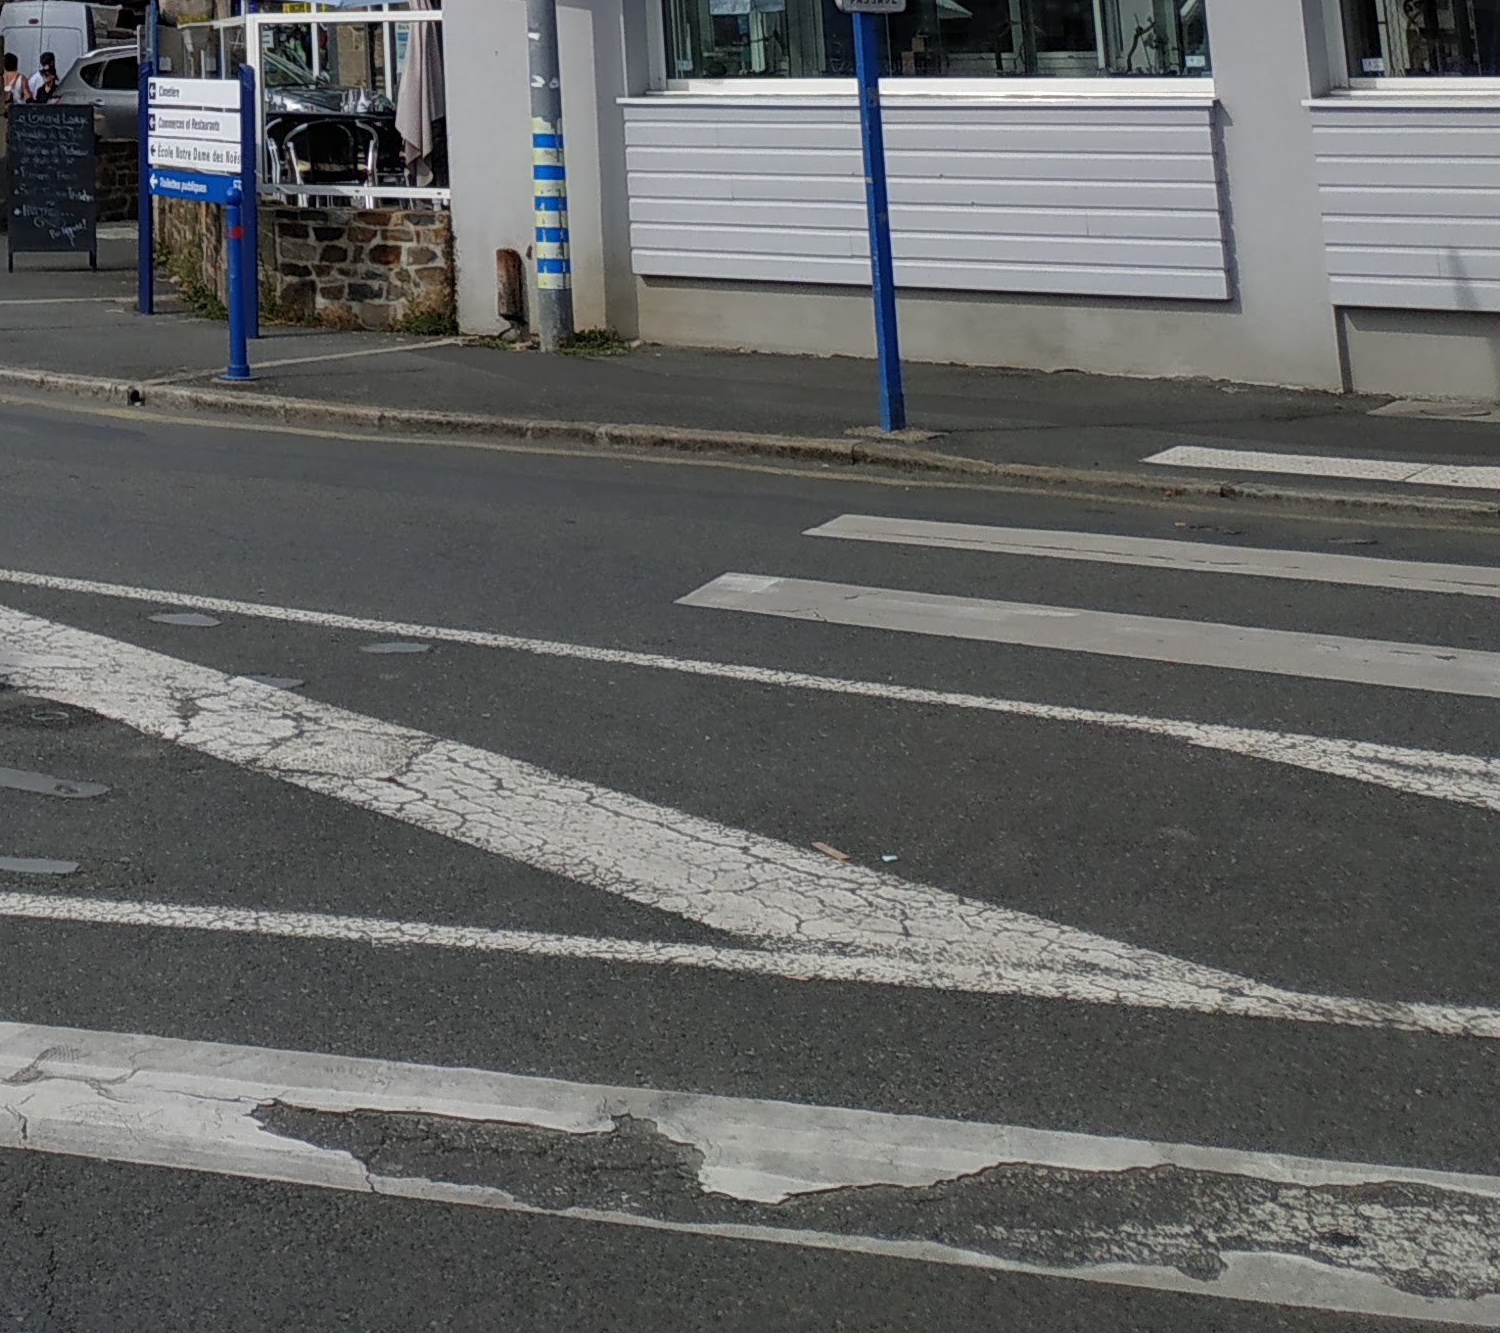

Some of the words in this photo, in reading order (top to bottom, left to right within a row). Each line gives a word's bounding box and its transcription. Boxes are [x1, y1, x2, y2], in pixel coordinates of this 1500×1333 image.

[192, 118, 220, 132] Restaurants
[157, 142, 173, 158] École
[175, 146, 191, 160] Notre
[193, 147, 210, 162] Dame
[212, 149, 224, 164] des
